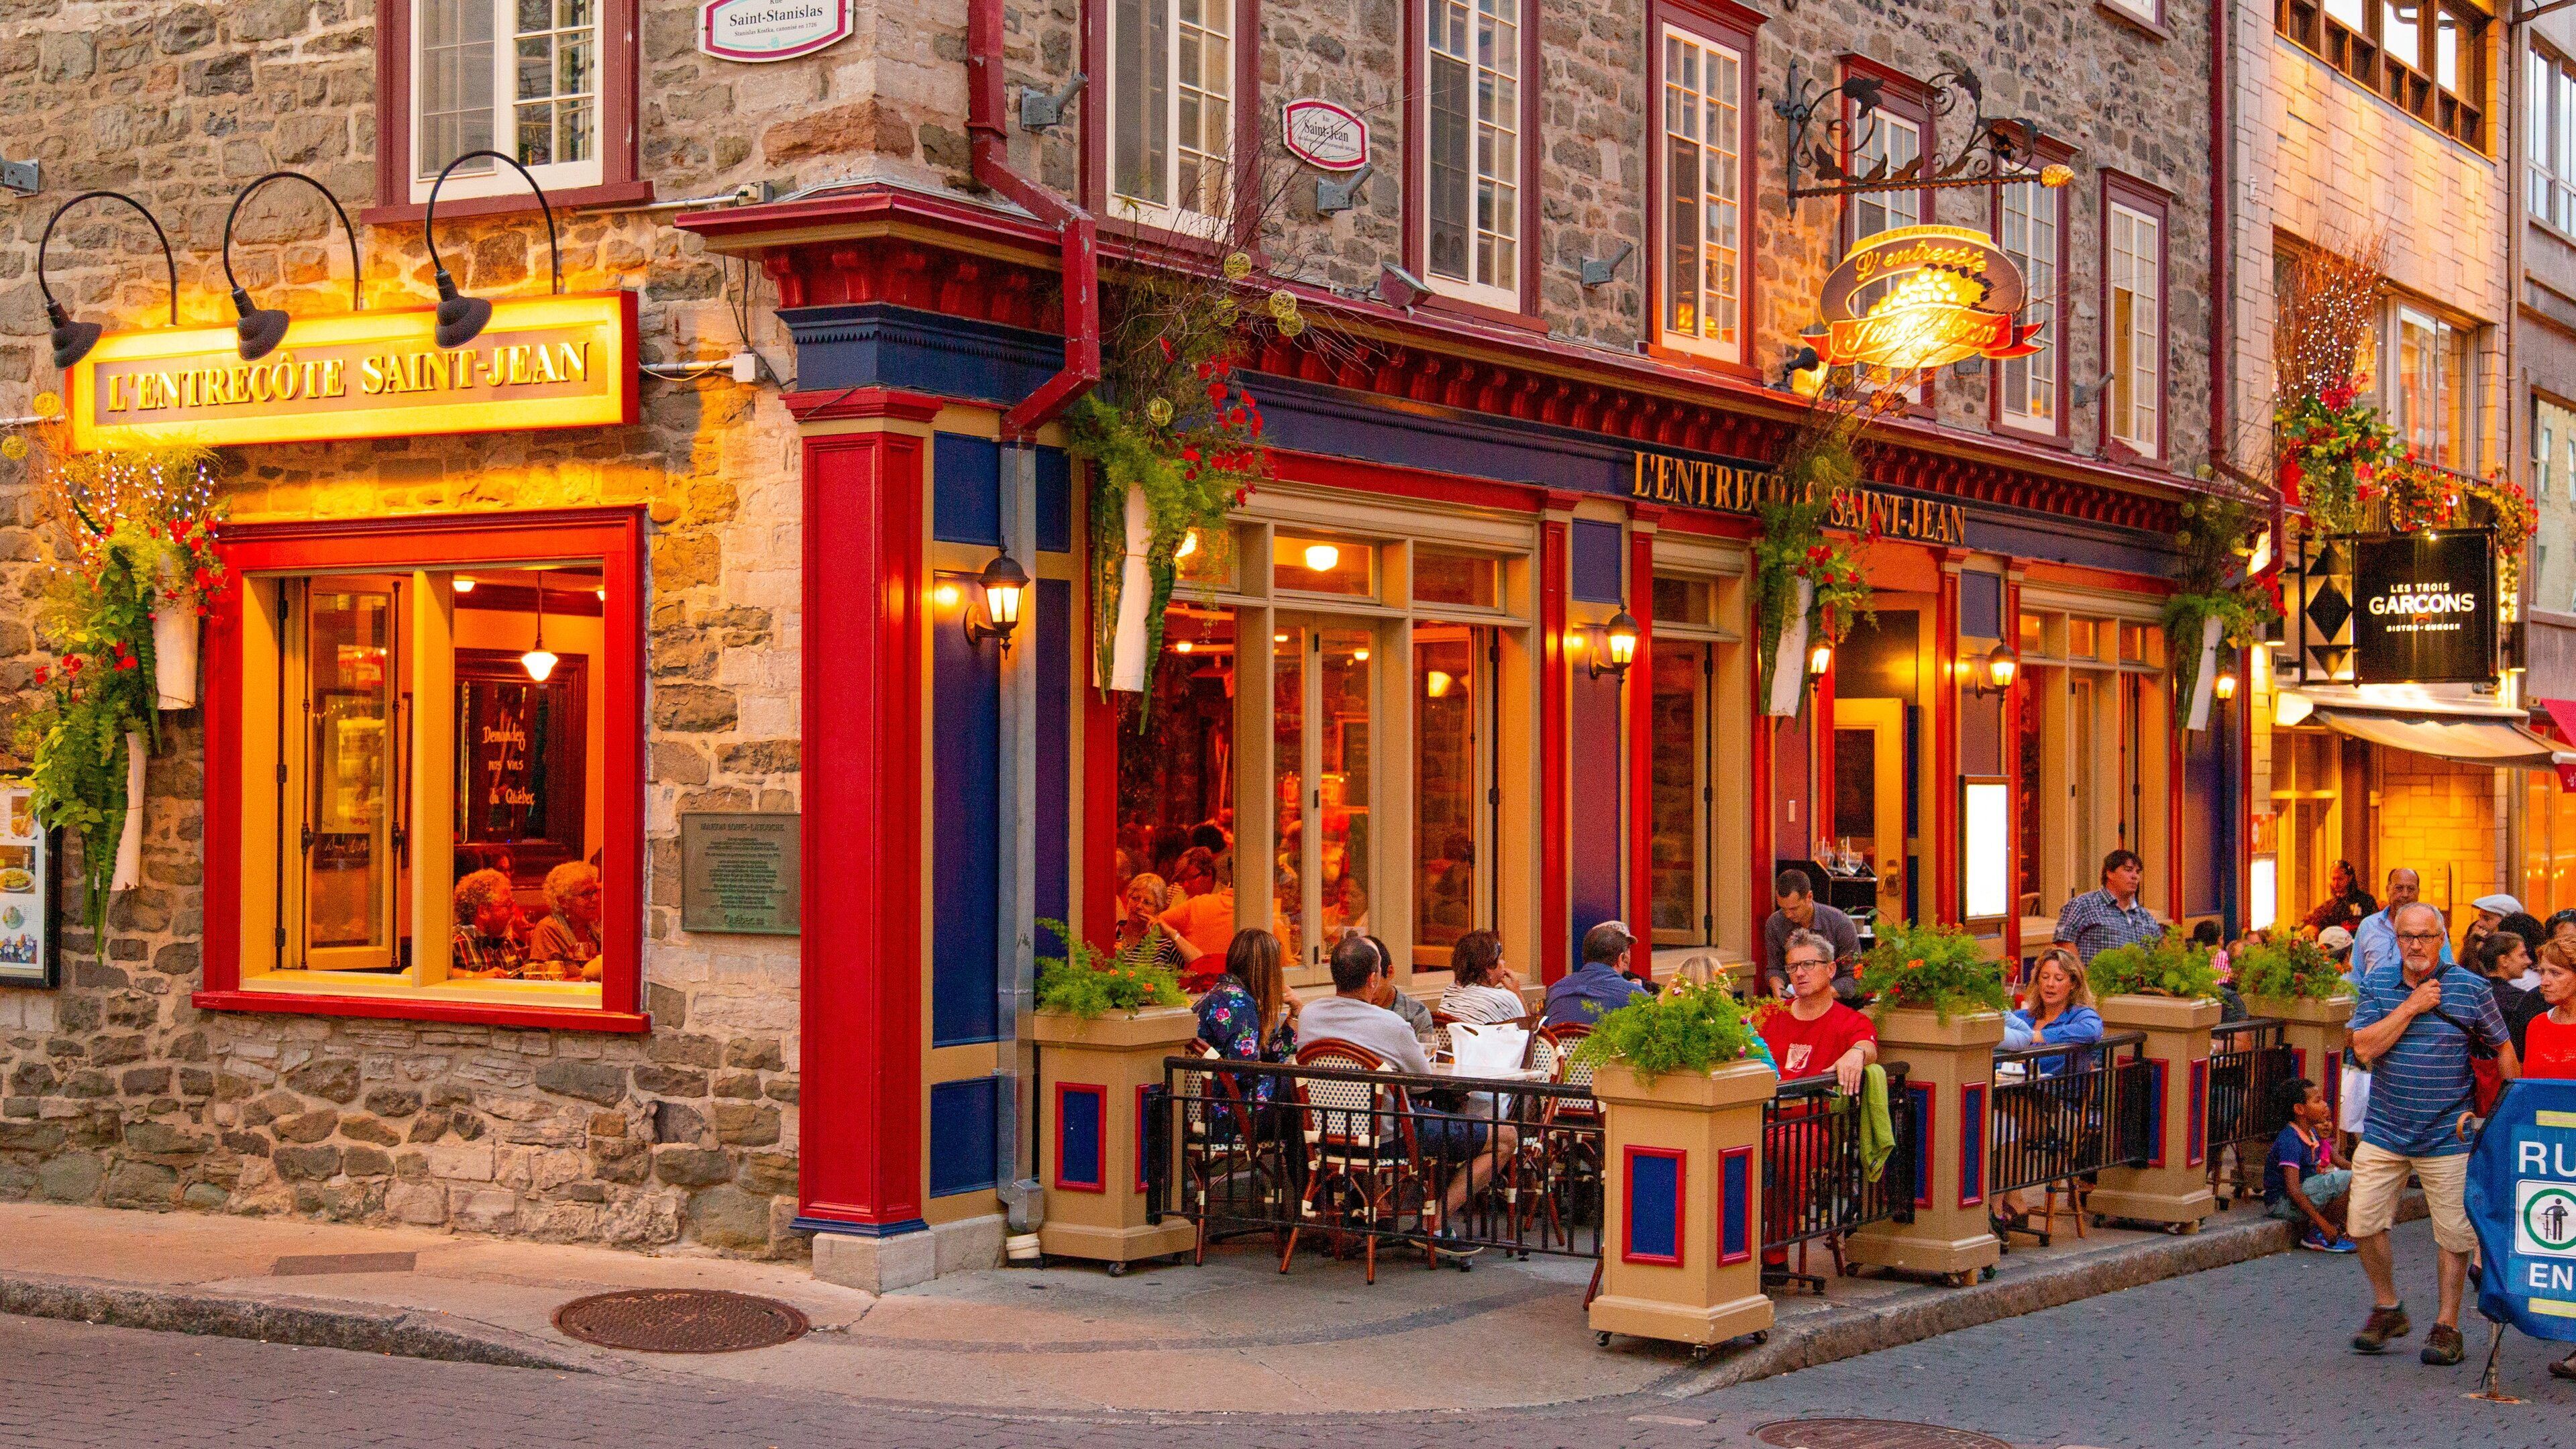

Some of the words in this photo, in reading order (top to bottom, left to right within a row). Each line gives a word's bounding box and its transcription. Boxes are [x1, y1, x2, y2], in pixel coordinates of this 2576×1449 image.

[729, 4, 823, 27] Saint-Stanislas
[1304, 119, 1348, 142] Saint-Jean
[1874, 225, 1971, 243] RESTAURANT
[105, 352, 346, 412] L'ENTRECÔTE
[362, 341, 589, 394] SAINT-JEAN
[1632, 450, 1815, 515] L'ENTREC
[1829, 485, 1966, 545] SAINT-JEAN
[2390, 584, 2412, 593] LES
[2416, 582, 2450, 592] TROIS
[506, 760, 523, 771] vins
[505, 786, 535, 805] Québec
